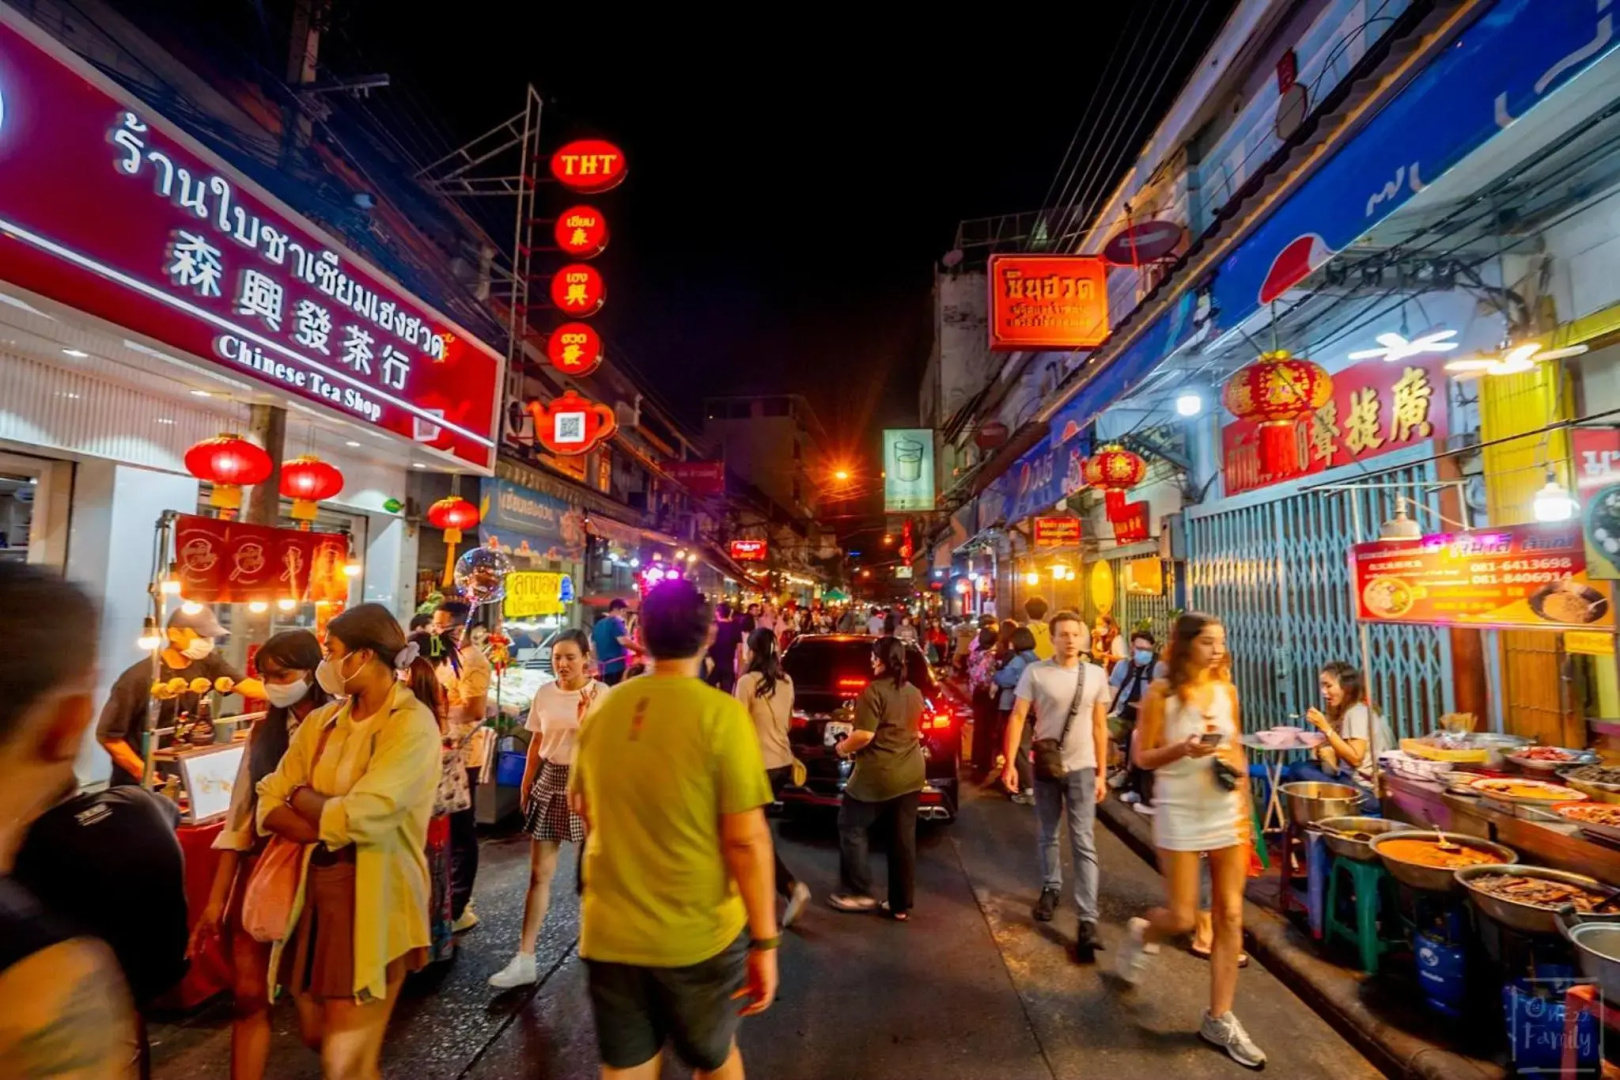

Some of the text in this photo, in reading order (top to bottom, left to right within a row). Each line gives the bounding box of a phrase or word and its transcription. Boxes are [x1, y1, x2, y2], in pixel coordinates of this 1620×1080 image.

[561, 154, 618, 175] THT
[218, 334, 382, 421] Chinese Tea Shop
